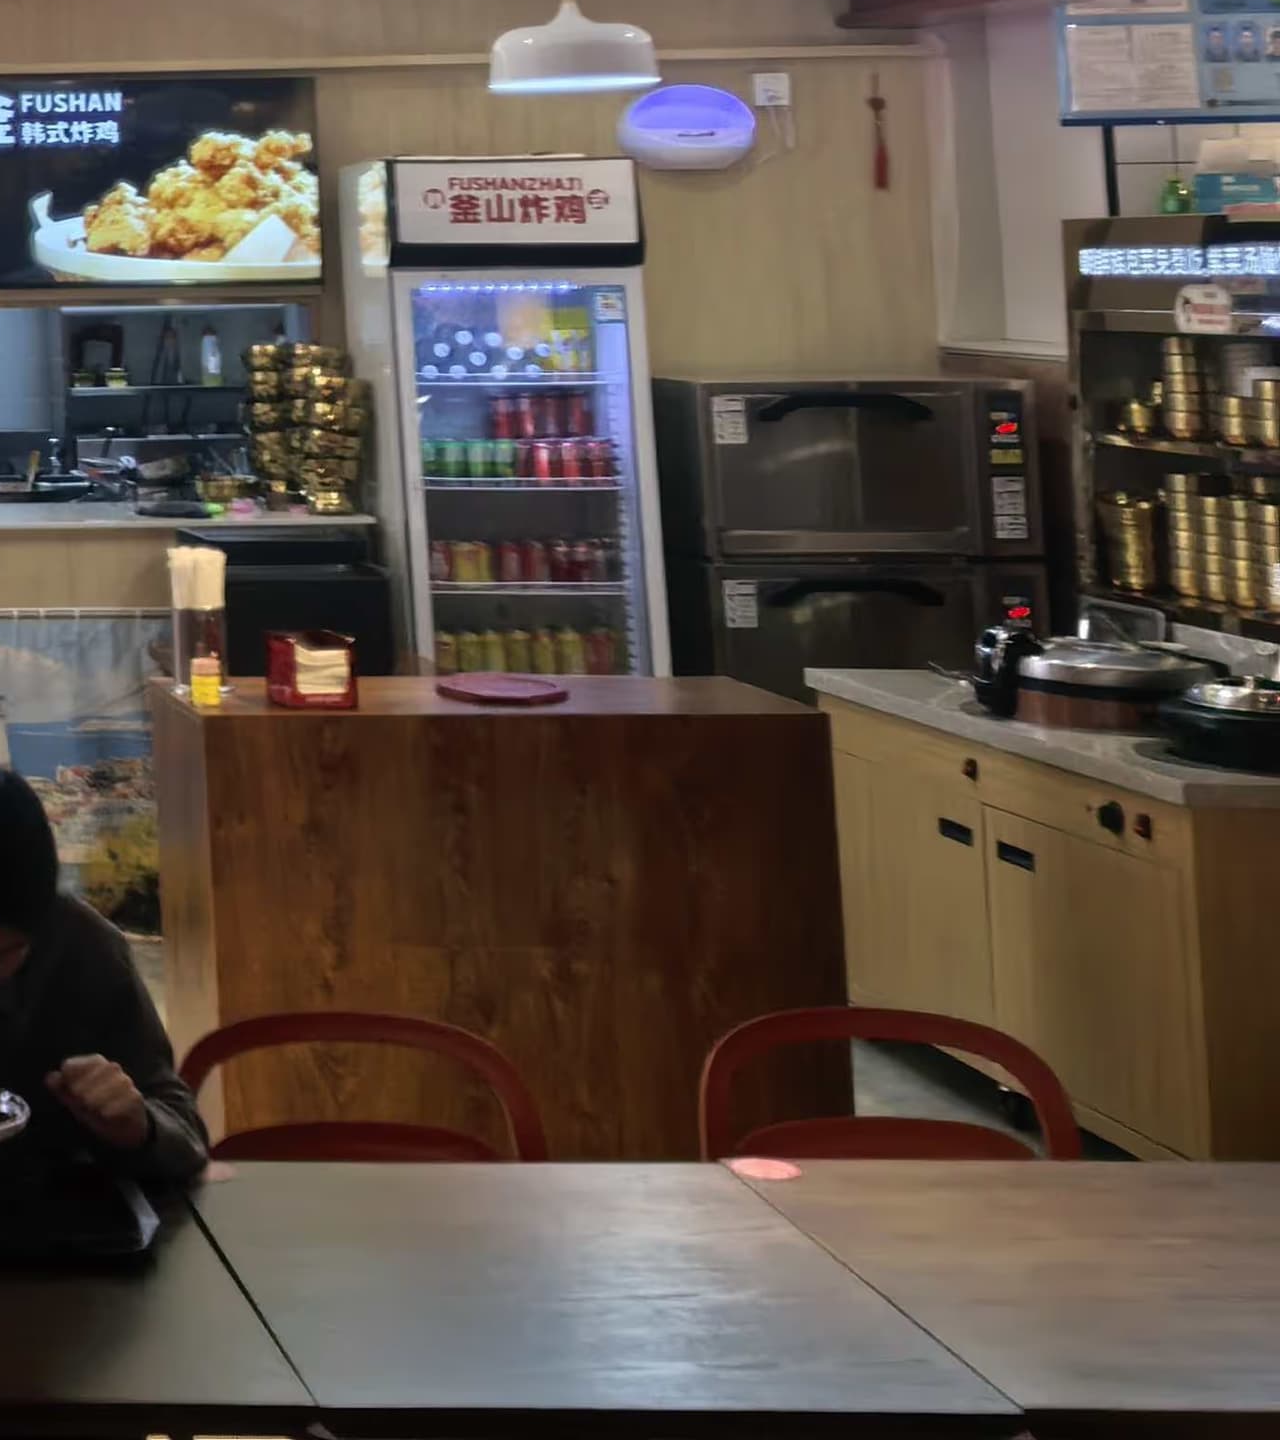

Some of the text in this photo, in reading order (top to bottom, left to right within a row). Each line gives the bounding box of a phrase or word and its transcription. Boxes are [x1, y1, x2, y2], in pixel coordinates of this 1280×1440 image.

[21, 93, 122, 113] FUSHAN
[21, 120, 119, 144] 韩式炸鸡
[447, 177, 583, 191] FUSHANZHAJI
[448, 194, 587, 224] 釜山炸鸡
